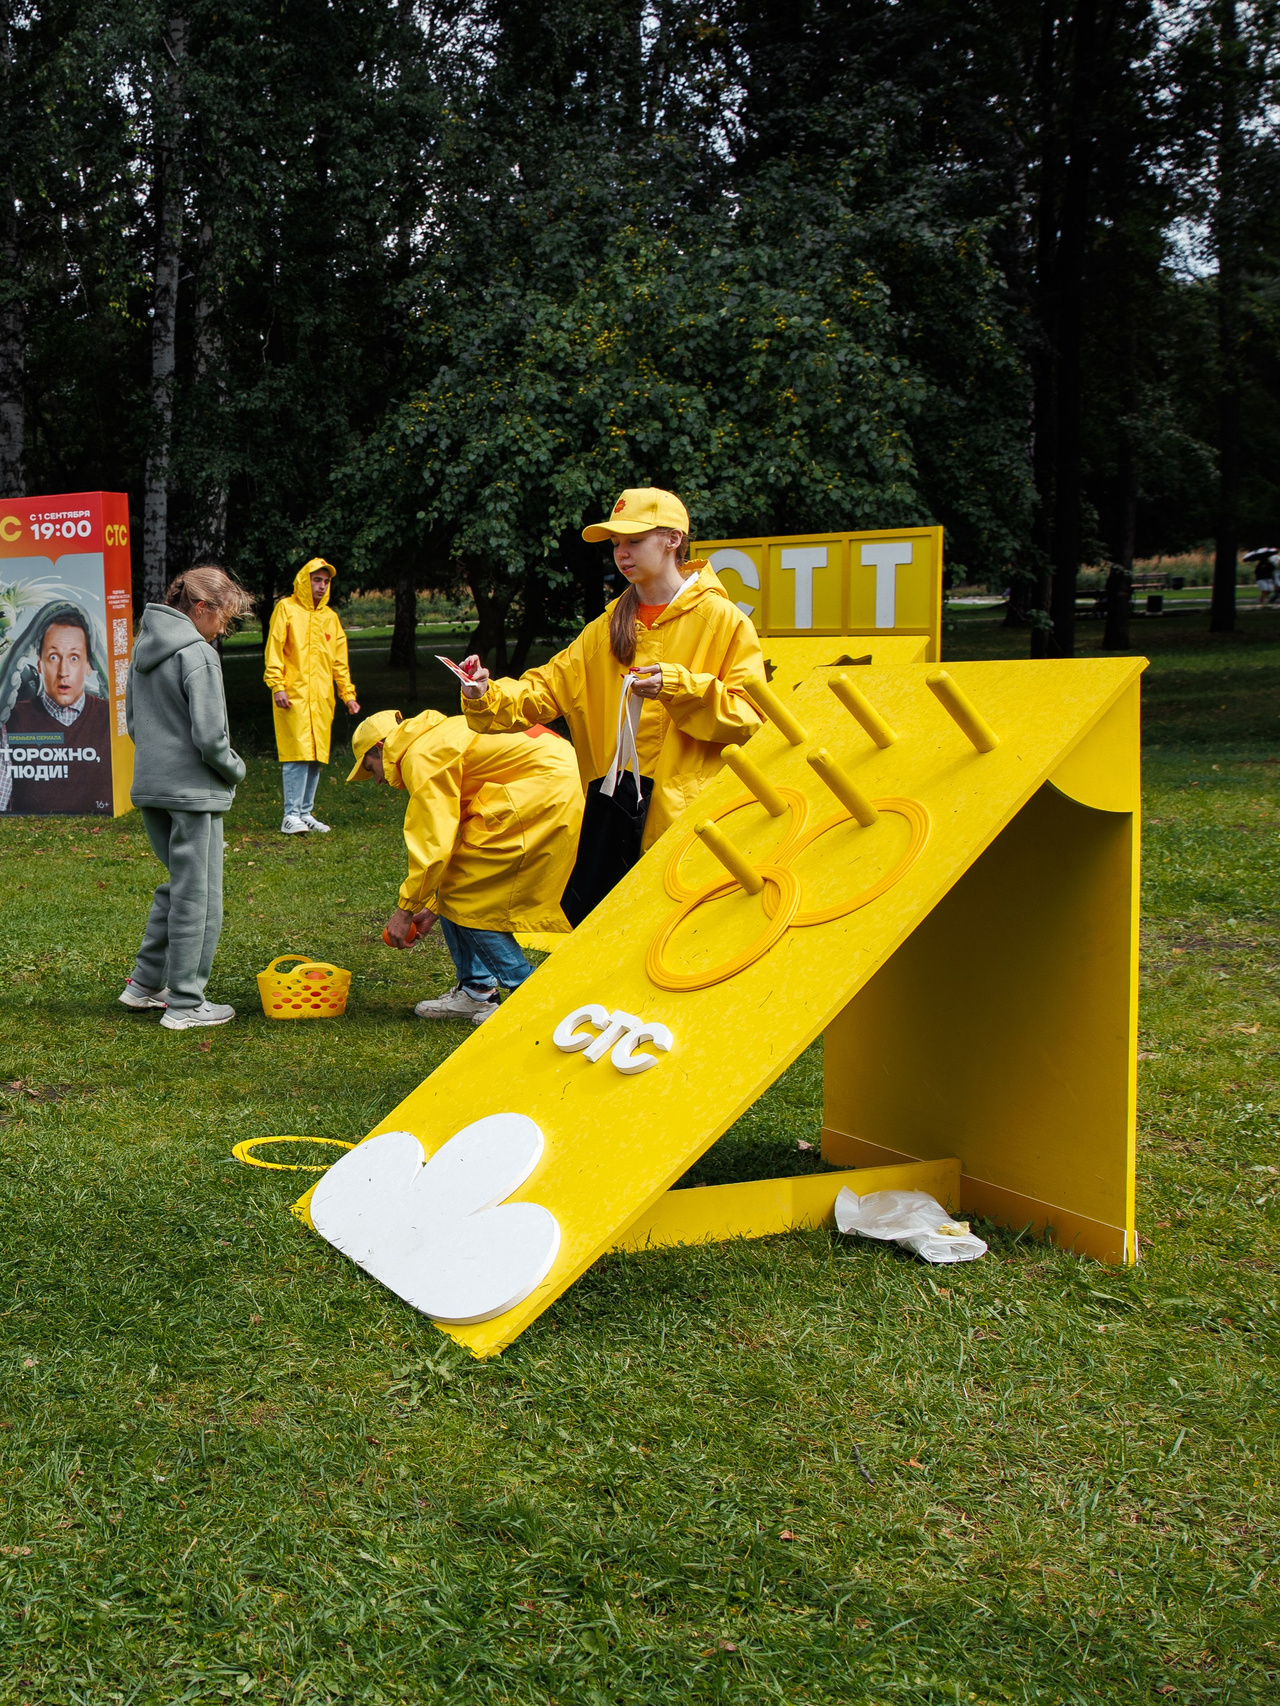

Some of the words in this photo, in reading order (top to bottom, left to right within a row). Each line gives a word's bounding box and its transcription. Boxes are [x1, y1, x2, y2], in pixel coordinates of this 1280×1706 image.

[44, 510, 91, 520] СЕНТЯБРЯ
[30, 520, 92, 540] 19:00
[105, 524, 128, 546] СТС
[6, 765, 68, 781] ЛЮДИ!
[95, 800, 110, 809] 16+
[553, 1004, 673, 1075] СТС
